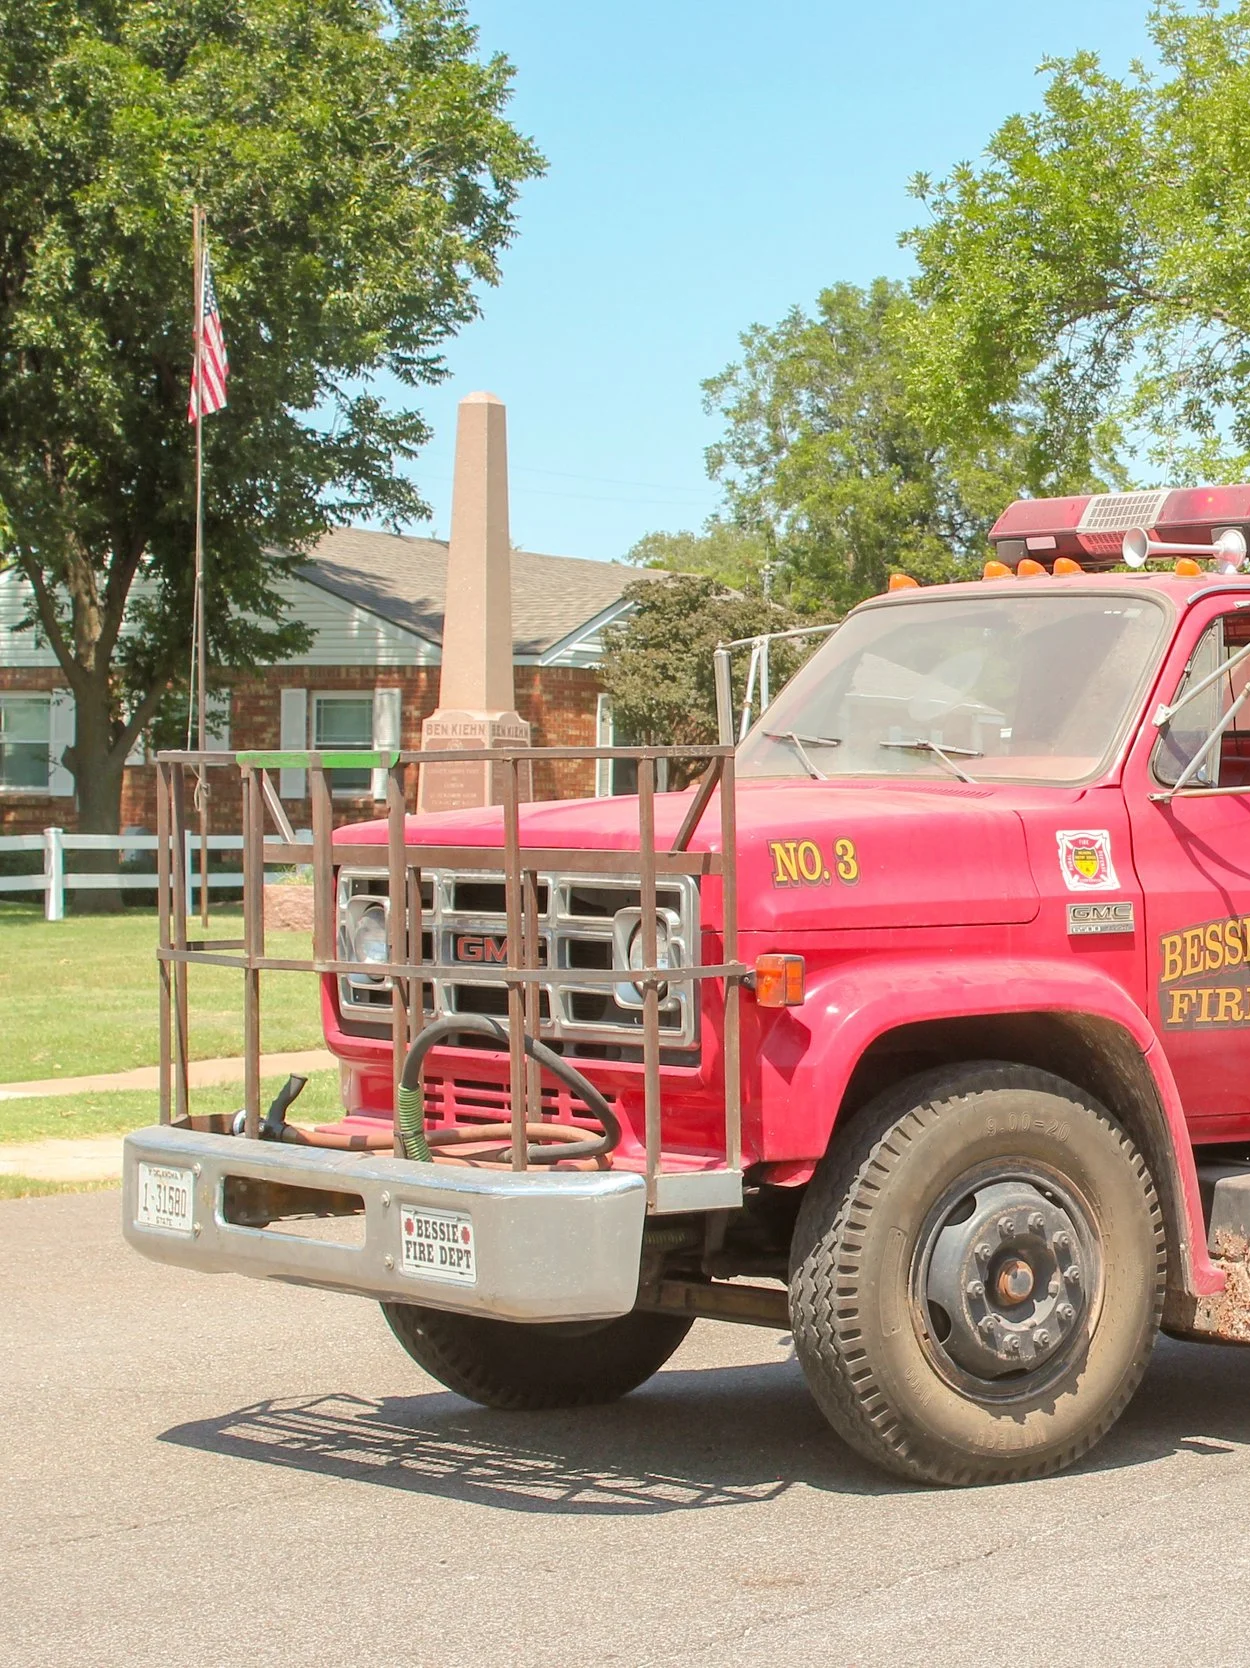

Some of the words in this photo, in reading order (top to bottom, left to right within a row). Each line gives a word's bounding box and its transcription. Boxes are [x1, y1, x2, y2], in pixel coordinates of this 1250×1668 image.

[426, 723, 448, 736] BEN
[450, 723, 485, 736] KIEHN
[770, 840, 830, 882] NO.
[835, 838, 858, 881] 3
[1071, 905, 1131, 921] GMC
[457, 936, 544, 963] GM
[416, 1218, 459, 1243] BESSIE
[405, 1240, 434, 1263] FIRE
[439, 1245, 472, 1269] DEPT
